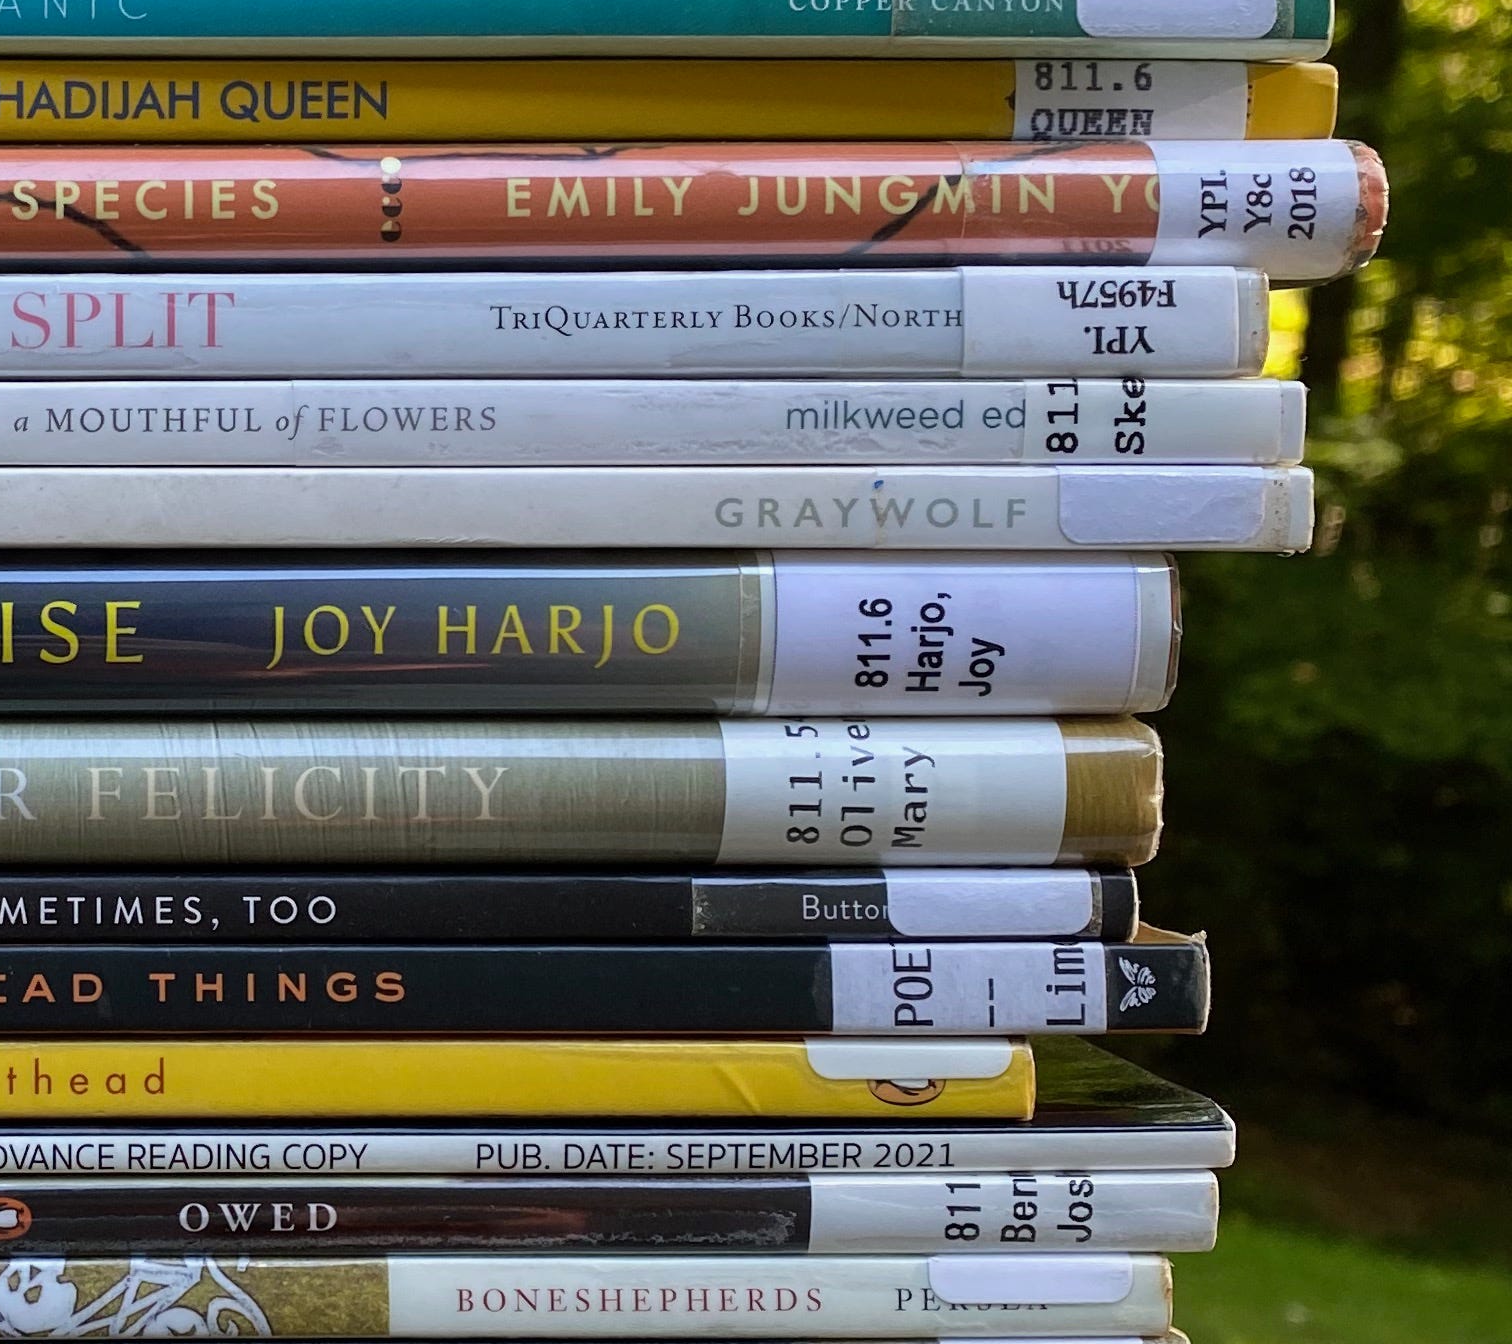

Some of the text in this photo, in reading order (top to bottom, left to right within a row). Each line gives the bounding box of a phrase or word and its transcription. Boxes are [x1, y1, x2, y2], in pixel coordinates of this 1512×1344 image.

[221, 80, 388, 122] QUEEN
[1031, 109, 1154, 140] QUEEN
[11, 180, 280, 219] SPECIES
[508, 175, 1056, 217] EMILY JUNGMIN
[1244, 174, 1273, 233] Y8c
[1289, 167, 1316, 240] 2018
[1057, 281, 1175, 309] F4957h
[15, 414, 29, 433] a
[46, 407, 261, 433] MOUTHFUL
[276, 405, 305, 439] of
[318, 406, 496, 432] FLOWERS
[786, 400, 963, 429] milkweed
[715, 498, 1026, 529] GRAYWOLF
[267, 603, 679, 669] JOY HARJO
[905, 593, 954, 691] Harjo,
[959, 638, 1005, 696] Joy
[891, 746, 935, 847] Mary
[150, 971, 407, 1003] THINGS
[126, 1144, 270, 1171] READING
[281, 1144, 367, 1170] COPY
[476, 1143, 954, 1171] PUB. DATE: SEPTEMBER 2021
[180, 1203, 336, 1233] OWED
[457, 1288, 823, 1312] BONESHEPHERDS
